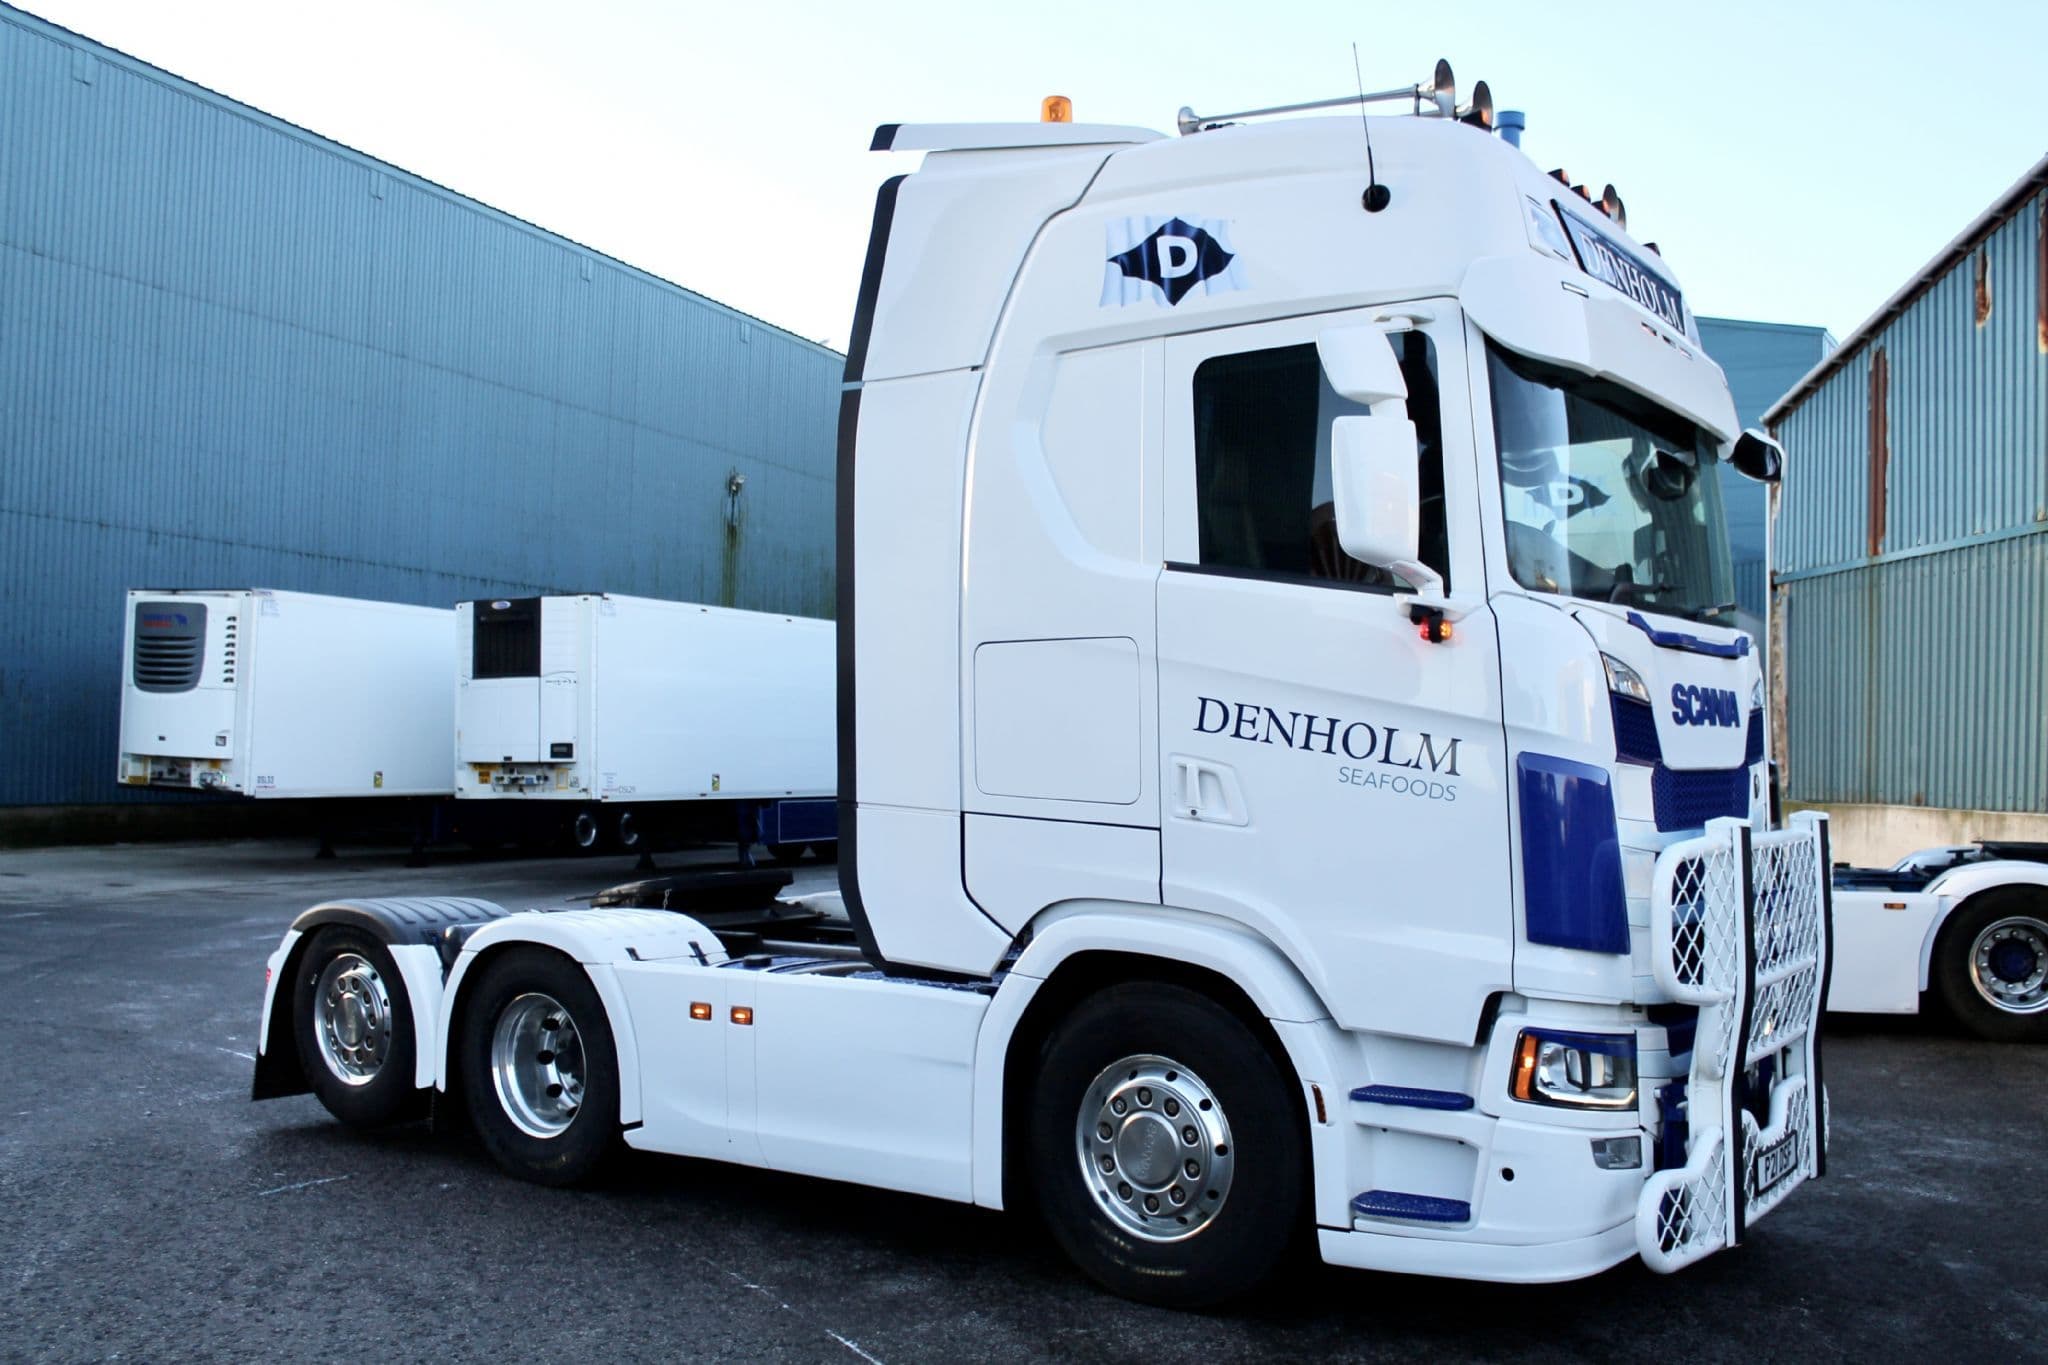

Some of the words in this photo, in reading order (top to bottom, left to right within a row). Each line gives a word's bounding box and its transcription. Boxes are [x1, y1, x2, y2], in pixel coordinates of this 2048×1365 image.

[1156, 235, 1198, 279] D
[1580, 231, 1684, 332] DENHOLM
[1548, 481, 1584, 507] D
[1671, 683, 1740, 728] SCANIA
[1193, 696, 1463, 777] DENHOLM
[1338, 766, 1457, 802] SEAFOODS
